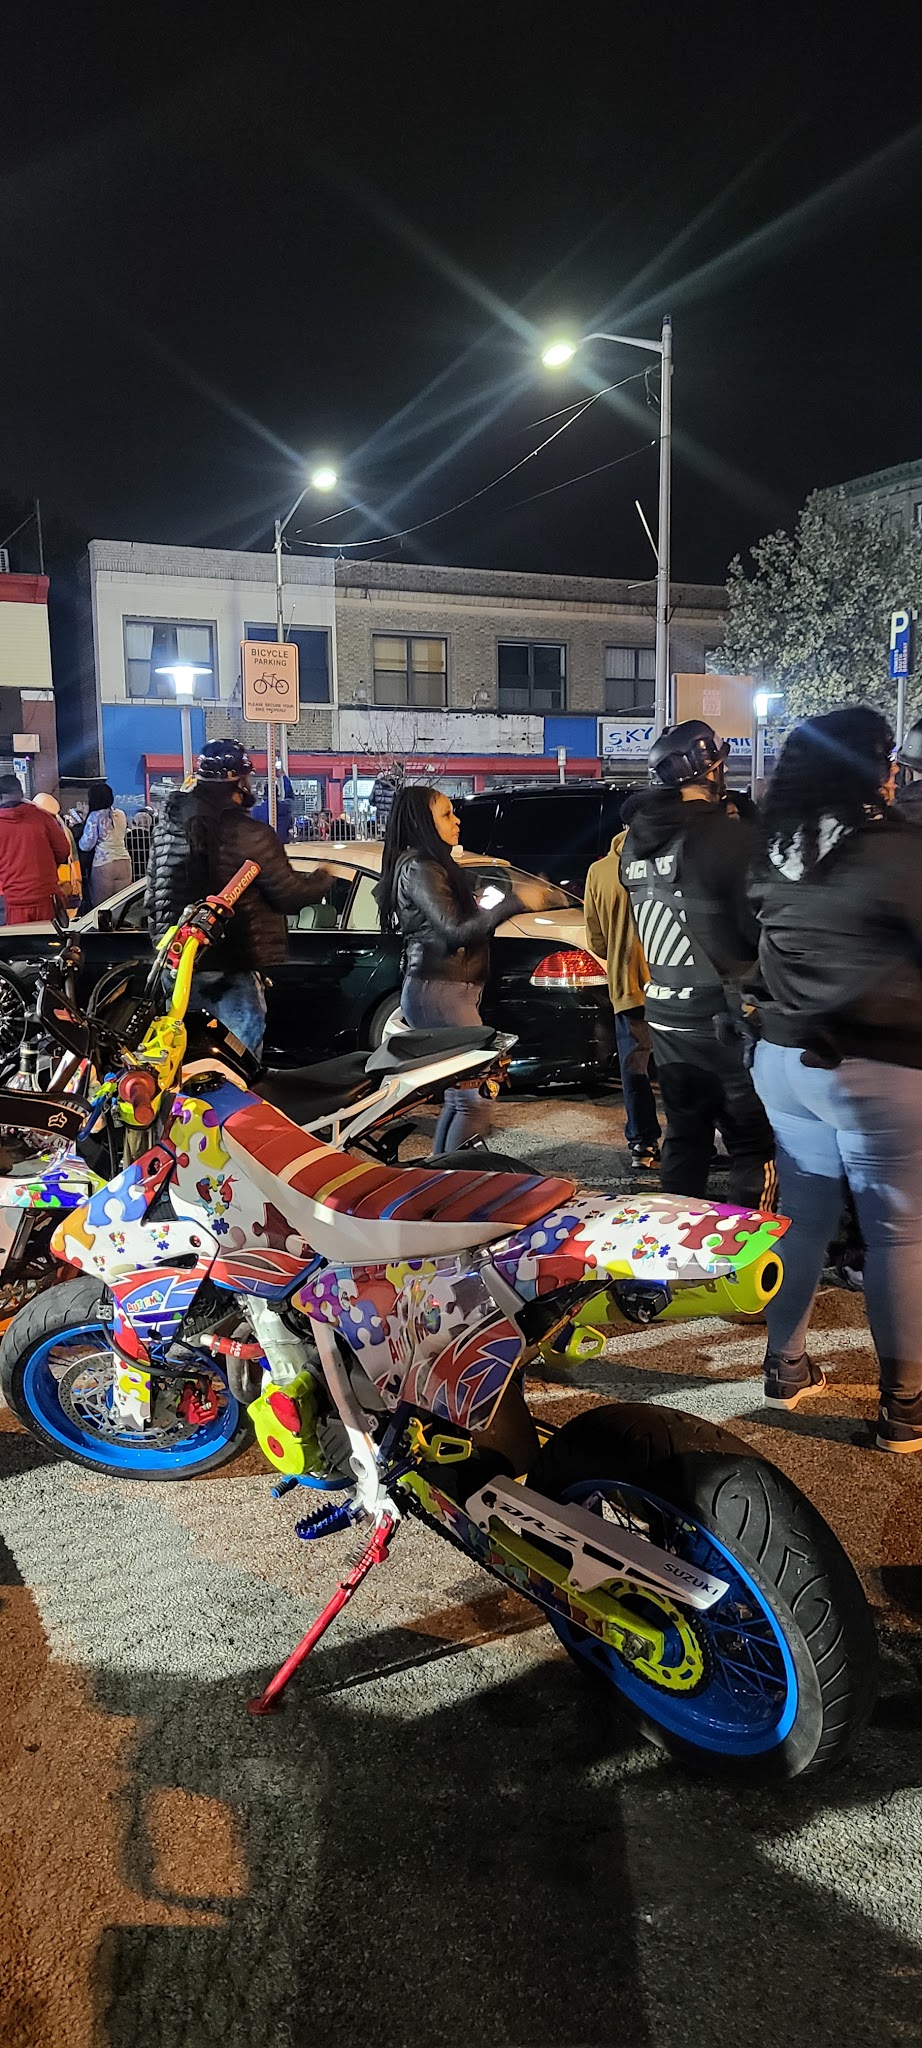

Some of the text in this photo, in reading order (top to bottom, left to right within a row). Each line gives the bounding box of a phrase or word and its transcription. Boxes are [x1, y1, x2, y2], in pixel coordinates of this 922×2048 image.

[890, 611, 909, 650] P
[251, 648, 289, 659] BICYCLE
[254, 658, 287, 667] PARKING
[608, 726, 654, 746] SKY
[223, 865, 258, 906] Supreme
[663, 1562, 719, 1596] SUZUKI
